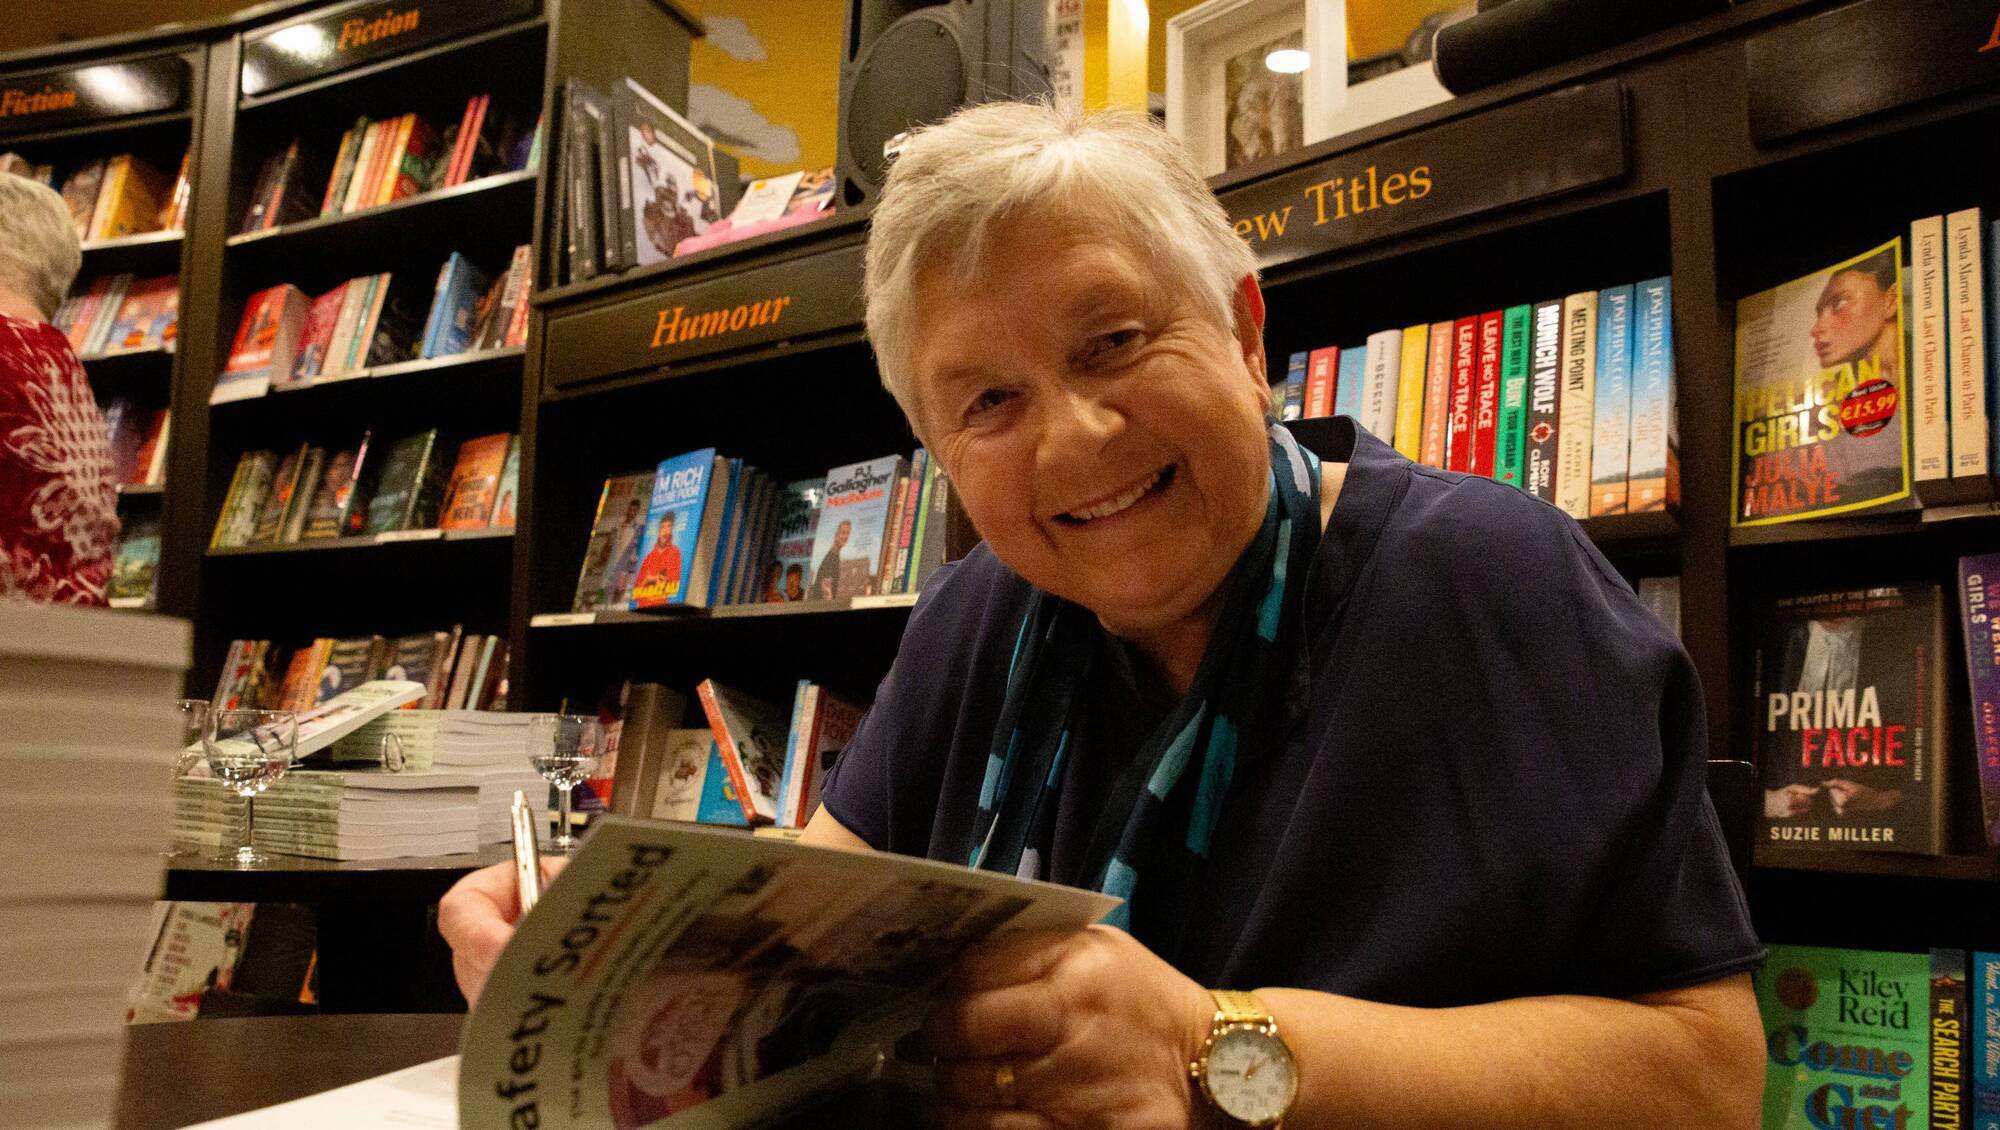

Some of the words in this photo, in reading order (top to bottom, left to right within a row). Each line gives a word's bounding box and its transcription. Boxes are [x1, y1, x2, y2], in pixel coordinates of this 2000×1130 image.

[338, 8, 420, 50] Fiction
[1, 88, 77, 117] Fiction
[1233, 206, 1294, 245] ew
[1304, 164, 1434, 228] Titles
[1918, 232, 1936, 266] Lynda
[1954, 225, 1972, 261] Lynda
[1922, 268, 1937, 310] Marron
[1958, 262, 1973, 304] Marron
[649, 295, 791, 349] Humour
[1480, 318, 1498, 363] LEAVE
[1511, 331, 1523, 349] BEST
[1512, 315, 1524, 330] THE
[1535, 304, 1560, 369] MUNICH
[1569, 307, 1587, 357] MELTING
[1922, 314, 1937, 339] Last
[1960, 308, 1974, 332] Last
[1457, 323, 1474, 367] LEAVE
[1922, 339, 1938, 381] Chance
[1960, 333, 1975, 377] Chance
[1314, 356, 1329, 377] THE
[1459, 369, 1470, 385] NO
[1483, 364, 1494, 381] NO
[1568, 358, 1585, 392] POINT
[1744, 353, 1883, 420] PELICAN
[1961, 378, 1974, 390] in
[1372, 363, 1386, 414] BEREST
[1453, 386, 1472, 433] TRACE
[1478, 381, 1497, 430] TRACE
[1505, 377, 1525, 408] BURY
[1532, 368, 1556, 415] WOLF
[1840, 393, 1897, 421] €15.99
[1923, 383, 1937, 395] in
[1962, 392, 1976, 421] Paris
[1744, 404, 1841, 457] GIRLS
[1923, 396, 1938, 425] Paris
[671, 464, 705, 492] RICH
[826, 473, 892, 496] Gallagher
[855, 465, 872, 478] PJ
[1529, 448, 1541, 496] CLEMENT
[1539, 459, 1551, 488] RORY
[1744, 445, 1829, 488] JULIA
[1743, 472, 1841, 517] MALYE
[1967, 573, 1988, 625] GIRLS
[1768, 685, 1882, 732] PRIMA
[1802, 725, 1906, 769] FACIE
[1983, 702, 2000, 768] ODAFEN
[1769, 826, 1820, 842] SUZIE
[1828, 826, 1895, 843] MILLER
[496, 992, 568, 1130] afety
[533, 843, 674, 977] Sorted
[1838, 967, 1910, 1000] Kiley
[1838, 995, 1910, 1030] Reid
[1938, 998, 1955, 1015] THE
[1767, 1024, 1915, 1082] Come
[1932, 1017, 1961, 1079] SEARCH
[1804, 1082, 1916, 1130] Get
[1932, 1080, 1961, 1130] PARTY
